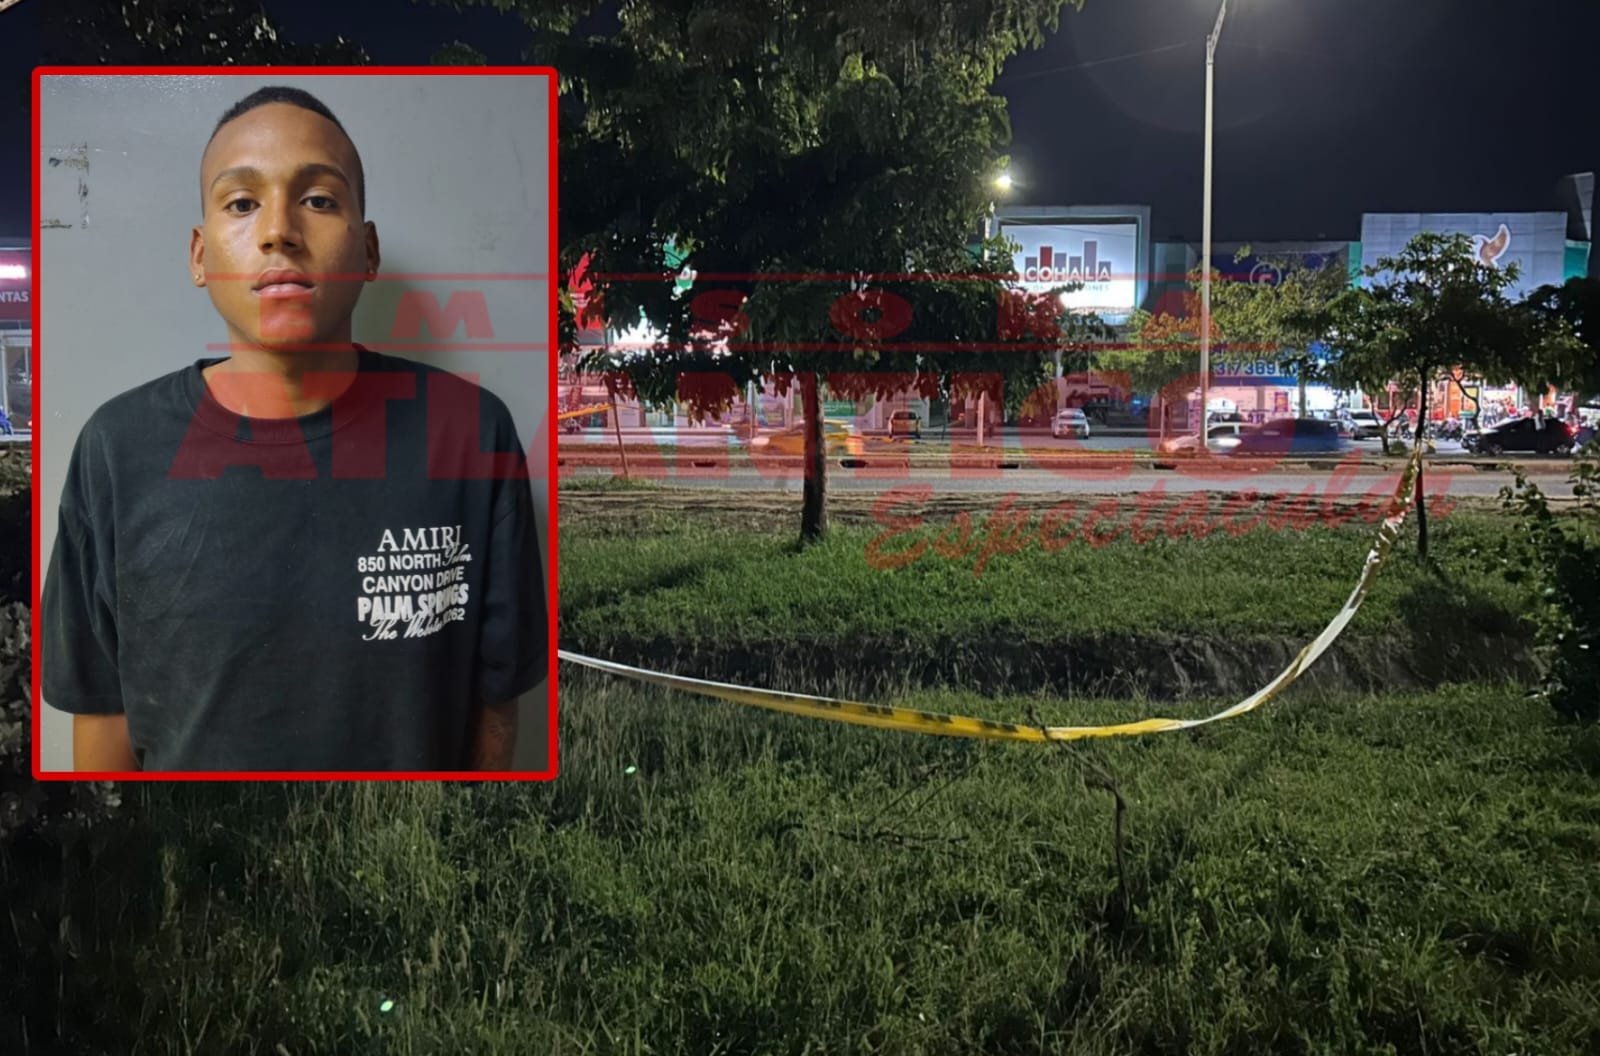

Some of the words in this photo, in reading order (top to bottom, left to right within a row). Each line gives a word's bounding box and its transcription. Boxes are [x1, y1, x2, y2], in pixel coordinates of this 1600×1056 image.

[1026, 266, 1111, 281] COHALA
[377, 525, 462, 553] AMIRI
[357, 556, 386, 573] 850
[389, 553, 441, 570] NORTH
[362, 573, 434, 594] CANYON
[358, 595, 415, 622] PALM
[362, 618, 398, 640] The
